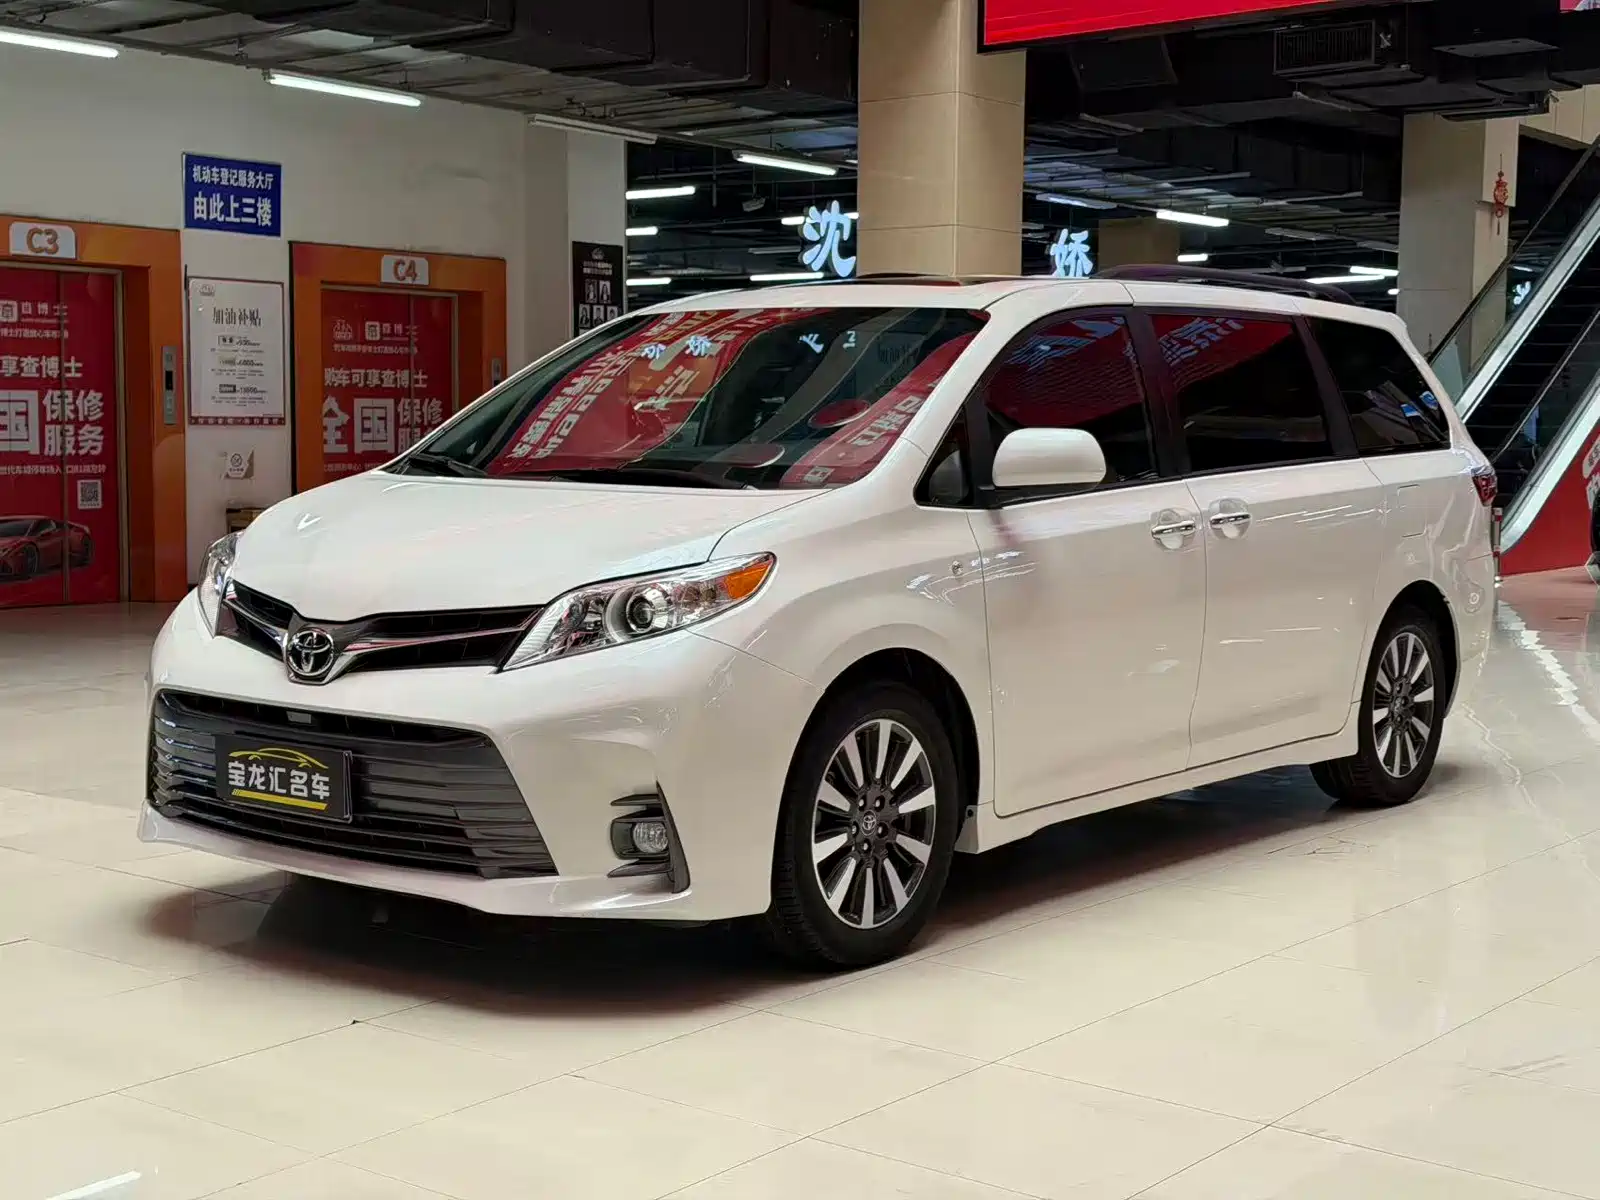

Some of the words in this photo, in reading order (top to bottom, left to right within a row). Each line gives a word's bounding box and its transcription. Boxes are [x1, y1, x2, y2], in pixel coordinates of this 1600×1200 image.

[192, 165, 274, 190] 机动车登记服务大厅
[193, 190, 272, 227] 由此上三楼
[26, 227, 60, 255] C3
[802, 200, 857, 278] 沈
[1050, 228, 1094, 279] 娇
[393, 259, 418, 283] C4
[212, 306, 262, 327] 加油补贴
[0, 355, 83, 378] 享查博士
[324, 366, 428, 389] 购车可享查博士
[42, 388, 105, 422] 保修
[397, 397, 443, 426] 保修
[322, 395, 396, 454] 全国
[44, 424, 105, 456] 服务
[398, 427, 432, 455] 服
[228, 760, 331, 800] 宝龙汇名车
